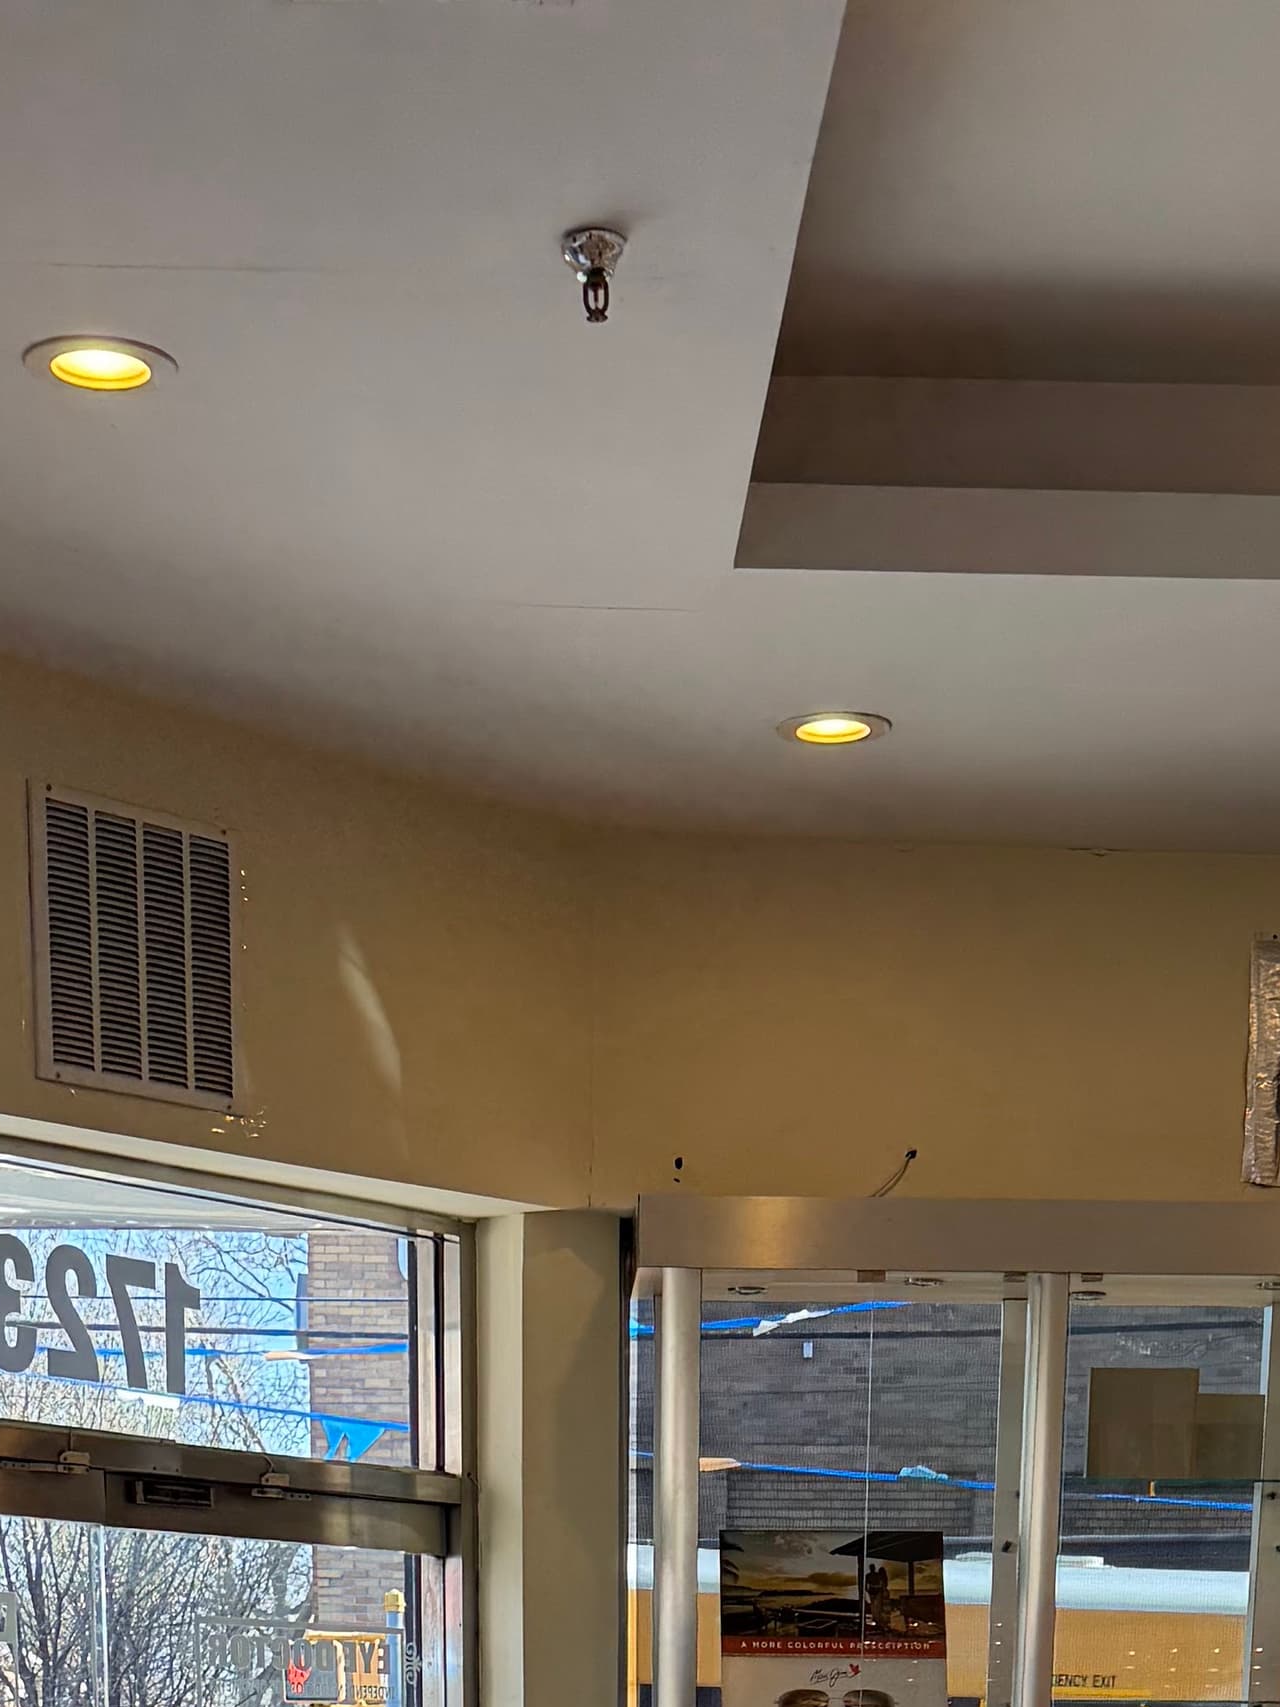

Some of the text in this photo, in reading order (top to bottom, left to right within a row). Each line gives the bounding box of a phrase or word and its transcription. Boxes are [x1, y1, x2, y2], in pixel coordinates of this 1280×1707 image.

[741, 1640, 748, 1649] A
[752, 1641, 783, 1649] MORE
[787, 1641, 845, 1650] COLORFUL
[1092, 1675, 1117, 1688] EXIT
